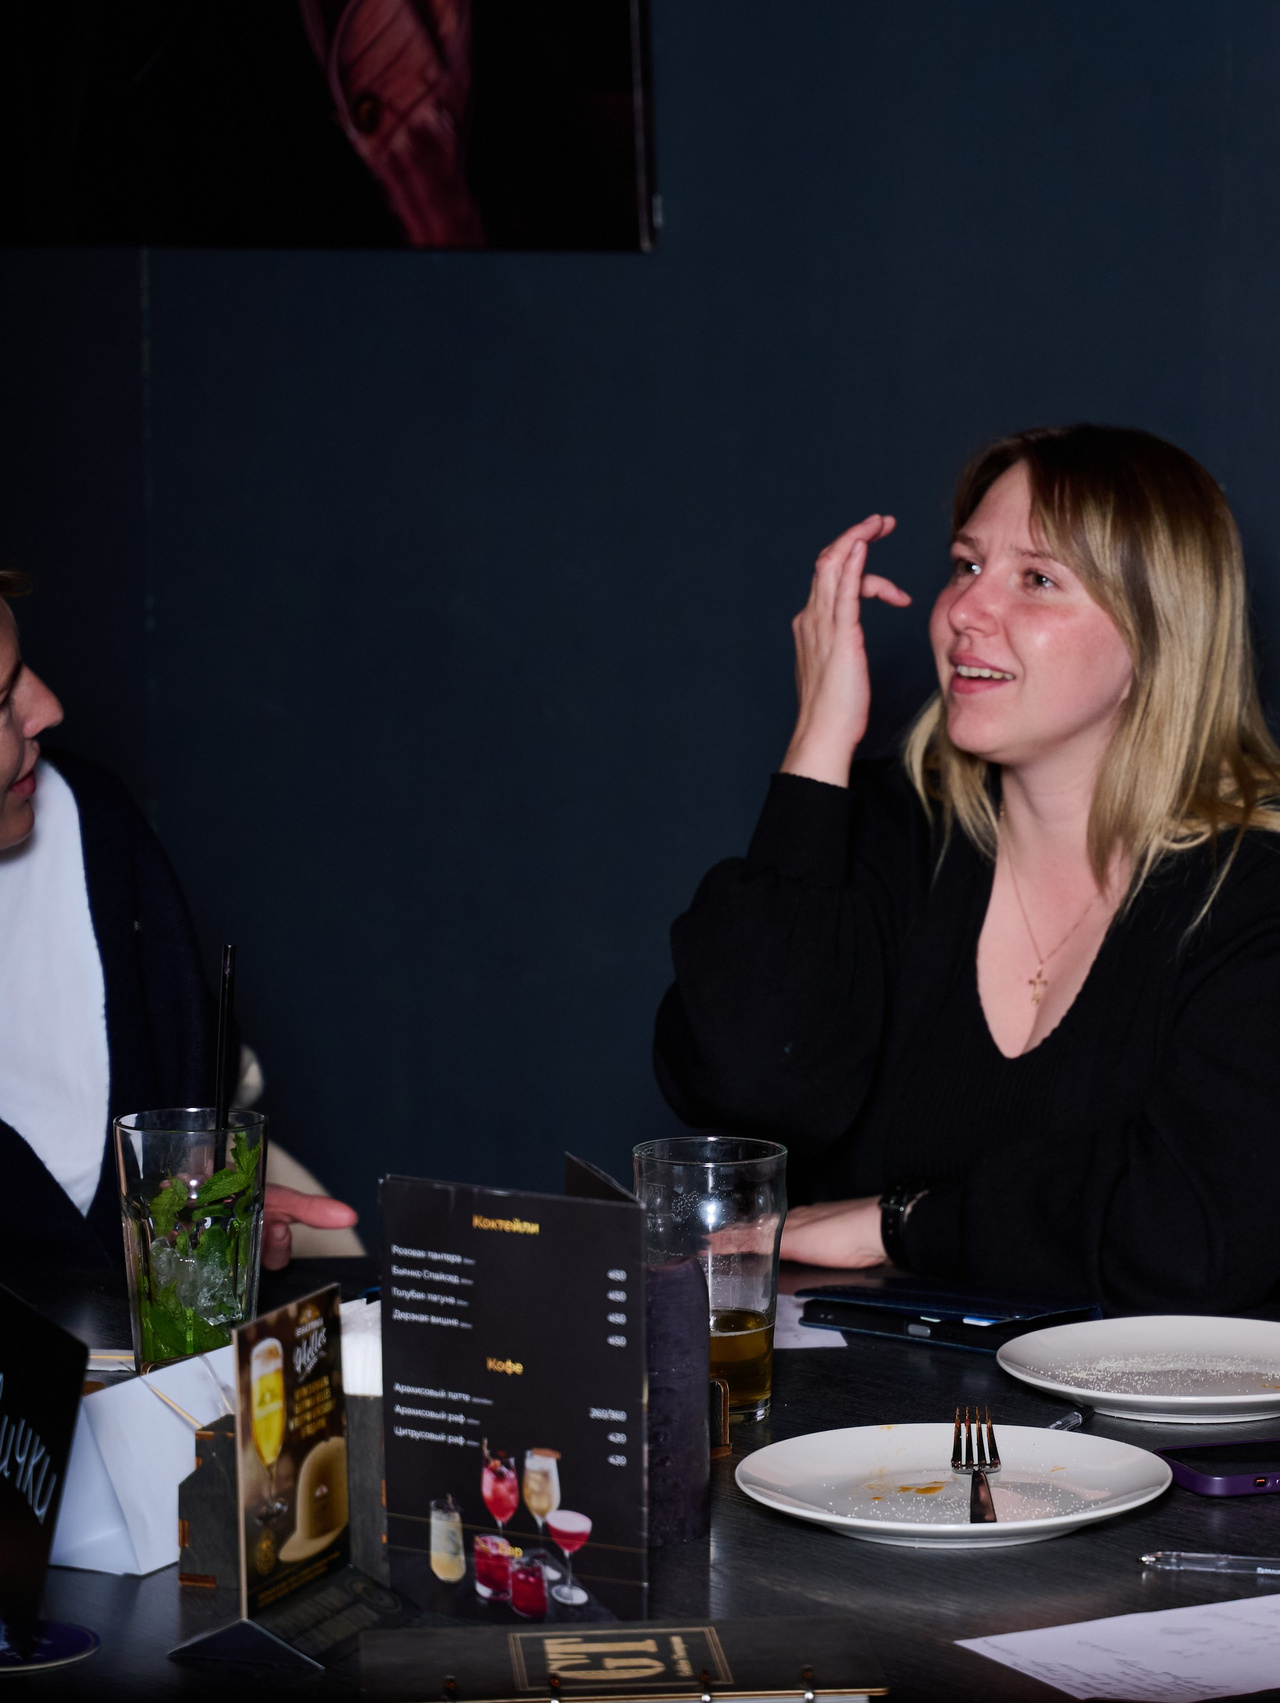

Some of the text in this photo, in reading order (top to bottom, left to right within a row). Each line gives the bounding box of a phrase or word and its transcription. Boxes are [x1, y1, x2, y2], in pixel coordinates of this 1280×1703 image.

[472, 1214, 540, 1235] Коктейли
[391, 1244, 426, 1258] Розовая
[428, 1250, 462, 1264] пантера
[391, 1264, 422, 1277] Бьянко
[391, 1286, 425, 1301] Голубая
[428, 1292, 456, 1305] лагуна
[392, 1308, 429, 1323] Дерзкая
[431, 1315, 459, 1326] вишня
[486, 1356, 524, 1376] Кофе
[393, 1382, 446, 1399] Арахисовый
[448, 1391, 471, 1402] латте
[394, 1404, 446, 1421] Арахисовый
[448, 1413, 466, 1425] раф
[393, 1425, 446, 1442] Цитрусовый
[448, 1434, 466, 1447] раф
